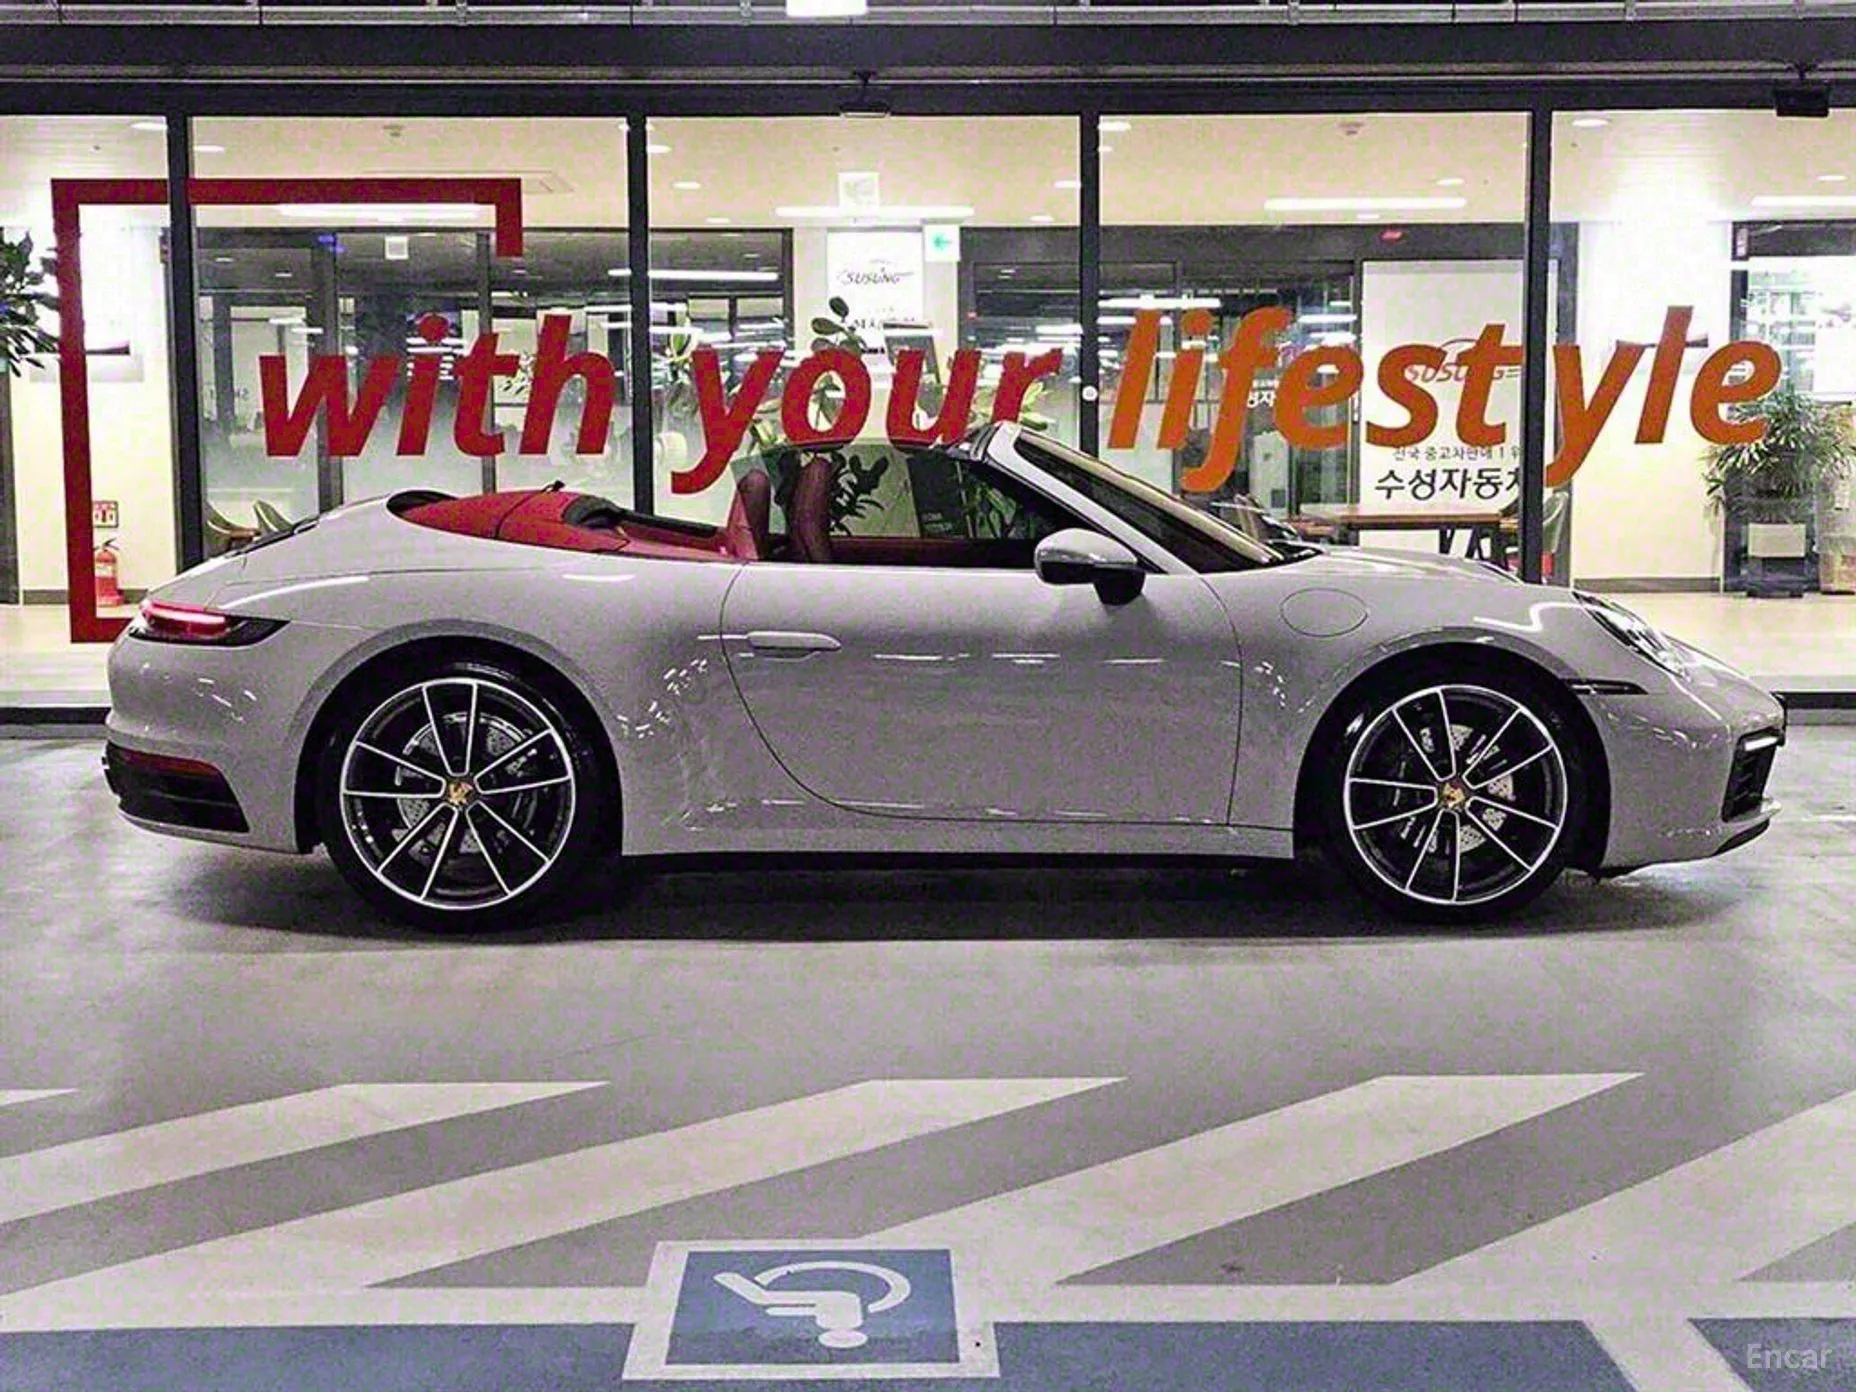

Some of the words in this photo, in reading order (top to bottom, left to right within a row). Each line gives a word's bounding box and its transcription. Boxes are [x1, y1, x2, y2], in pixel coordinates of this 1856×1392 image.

[258, 312, 617, 457] with
[670, 348, 1063, 494] your
[1108, 305, 1782, 492] lifestyle
[1404, 363, 1504, 382] SUSUG
